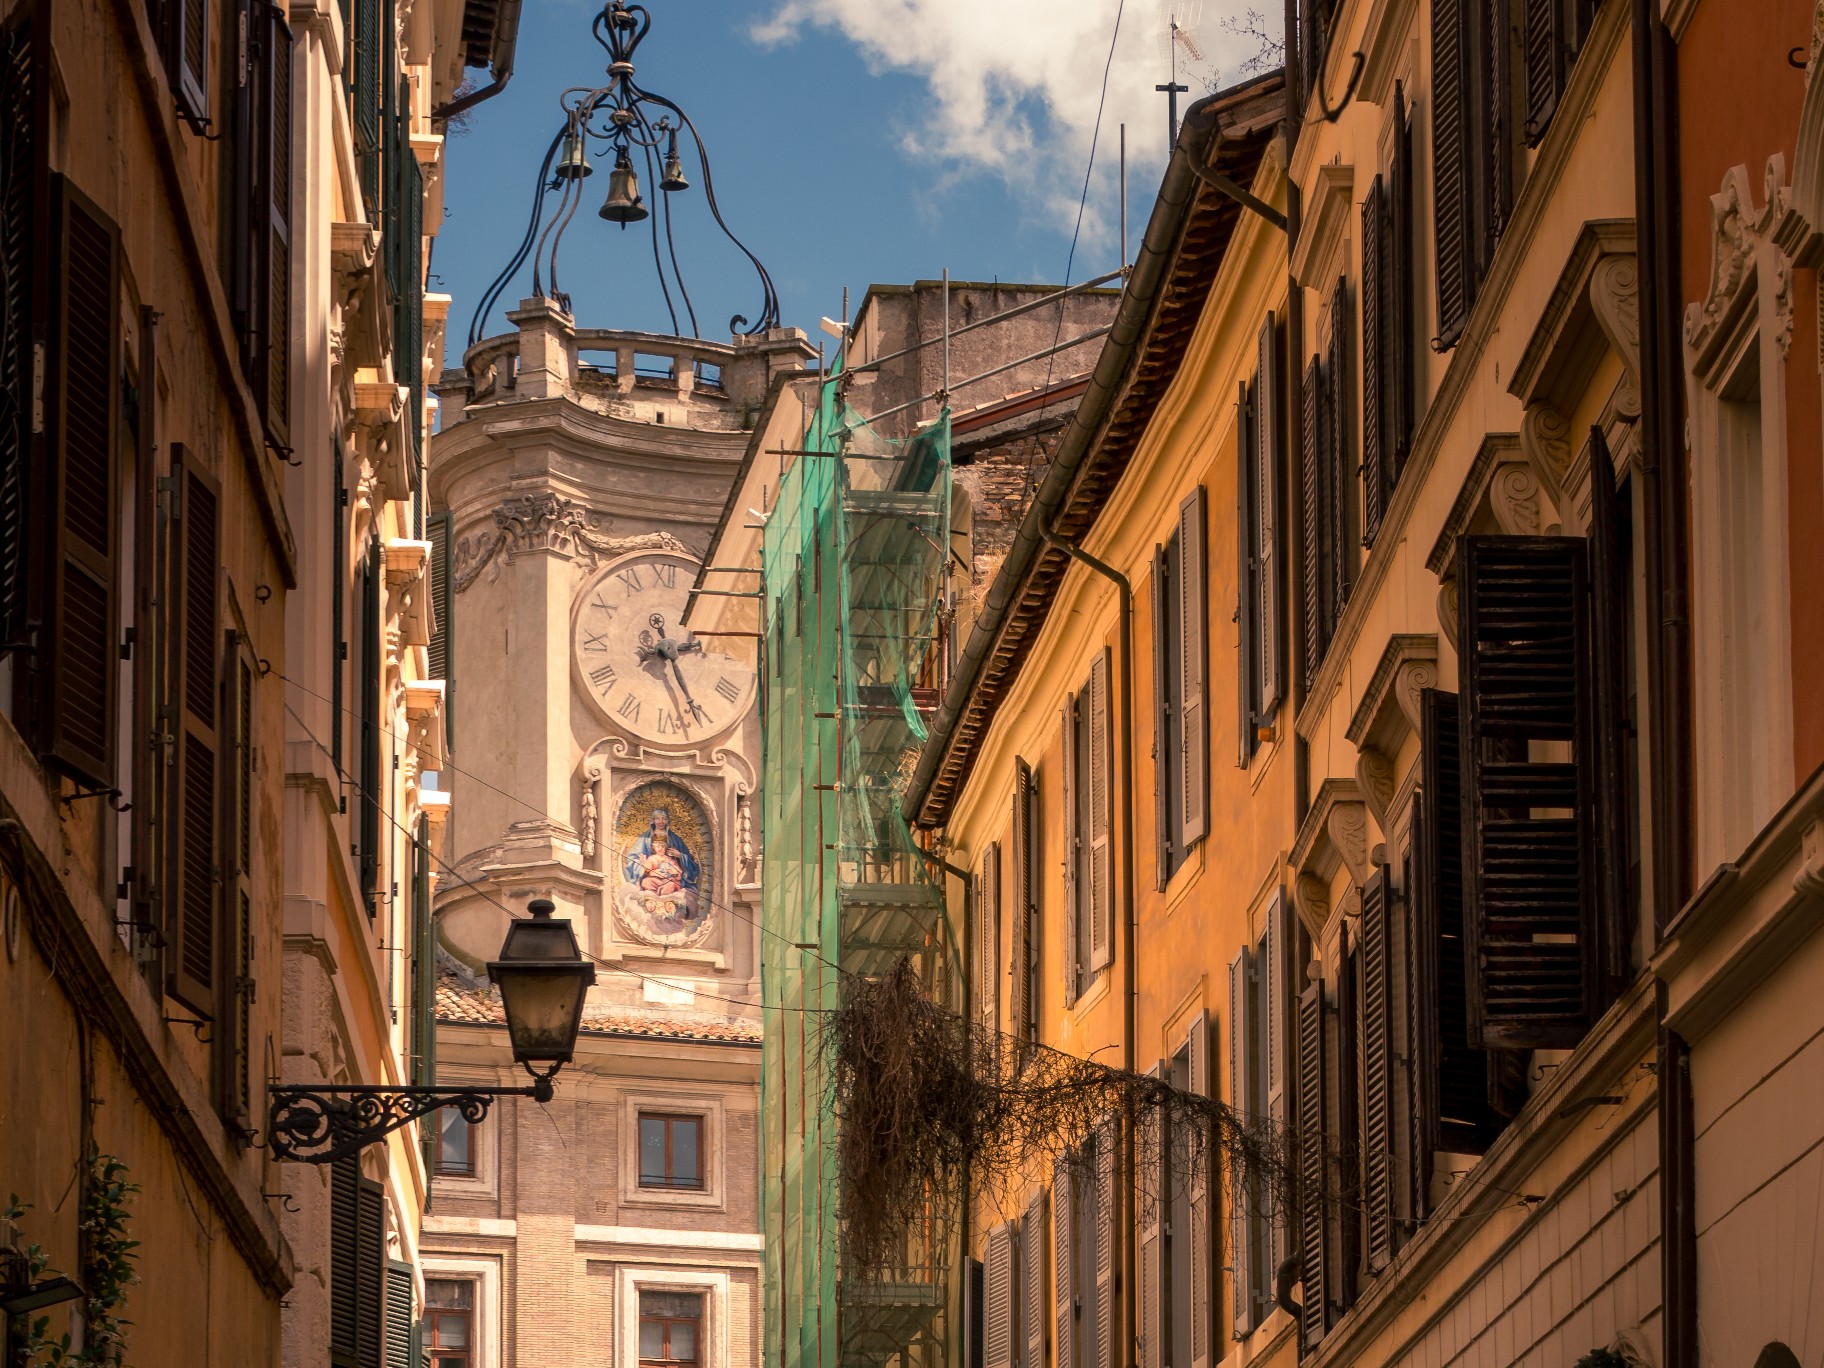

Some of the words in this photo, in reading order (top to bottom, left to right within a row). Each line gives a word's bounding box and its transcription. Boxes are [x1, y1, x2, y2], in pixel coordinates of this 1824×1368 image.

[616, 567, 644, 597] XI
[652, 563, 677, 589] XII
[591, 593, 617, 619] X
[584, 629, 608, 652] IX
[589, 664, 618, 697] VIII
[715, 676, 741, 703] IIII
[617, 693, 643, 724] VII
[657, 708, 678, 735] VI
